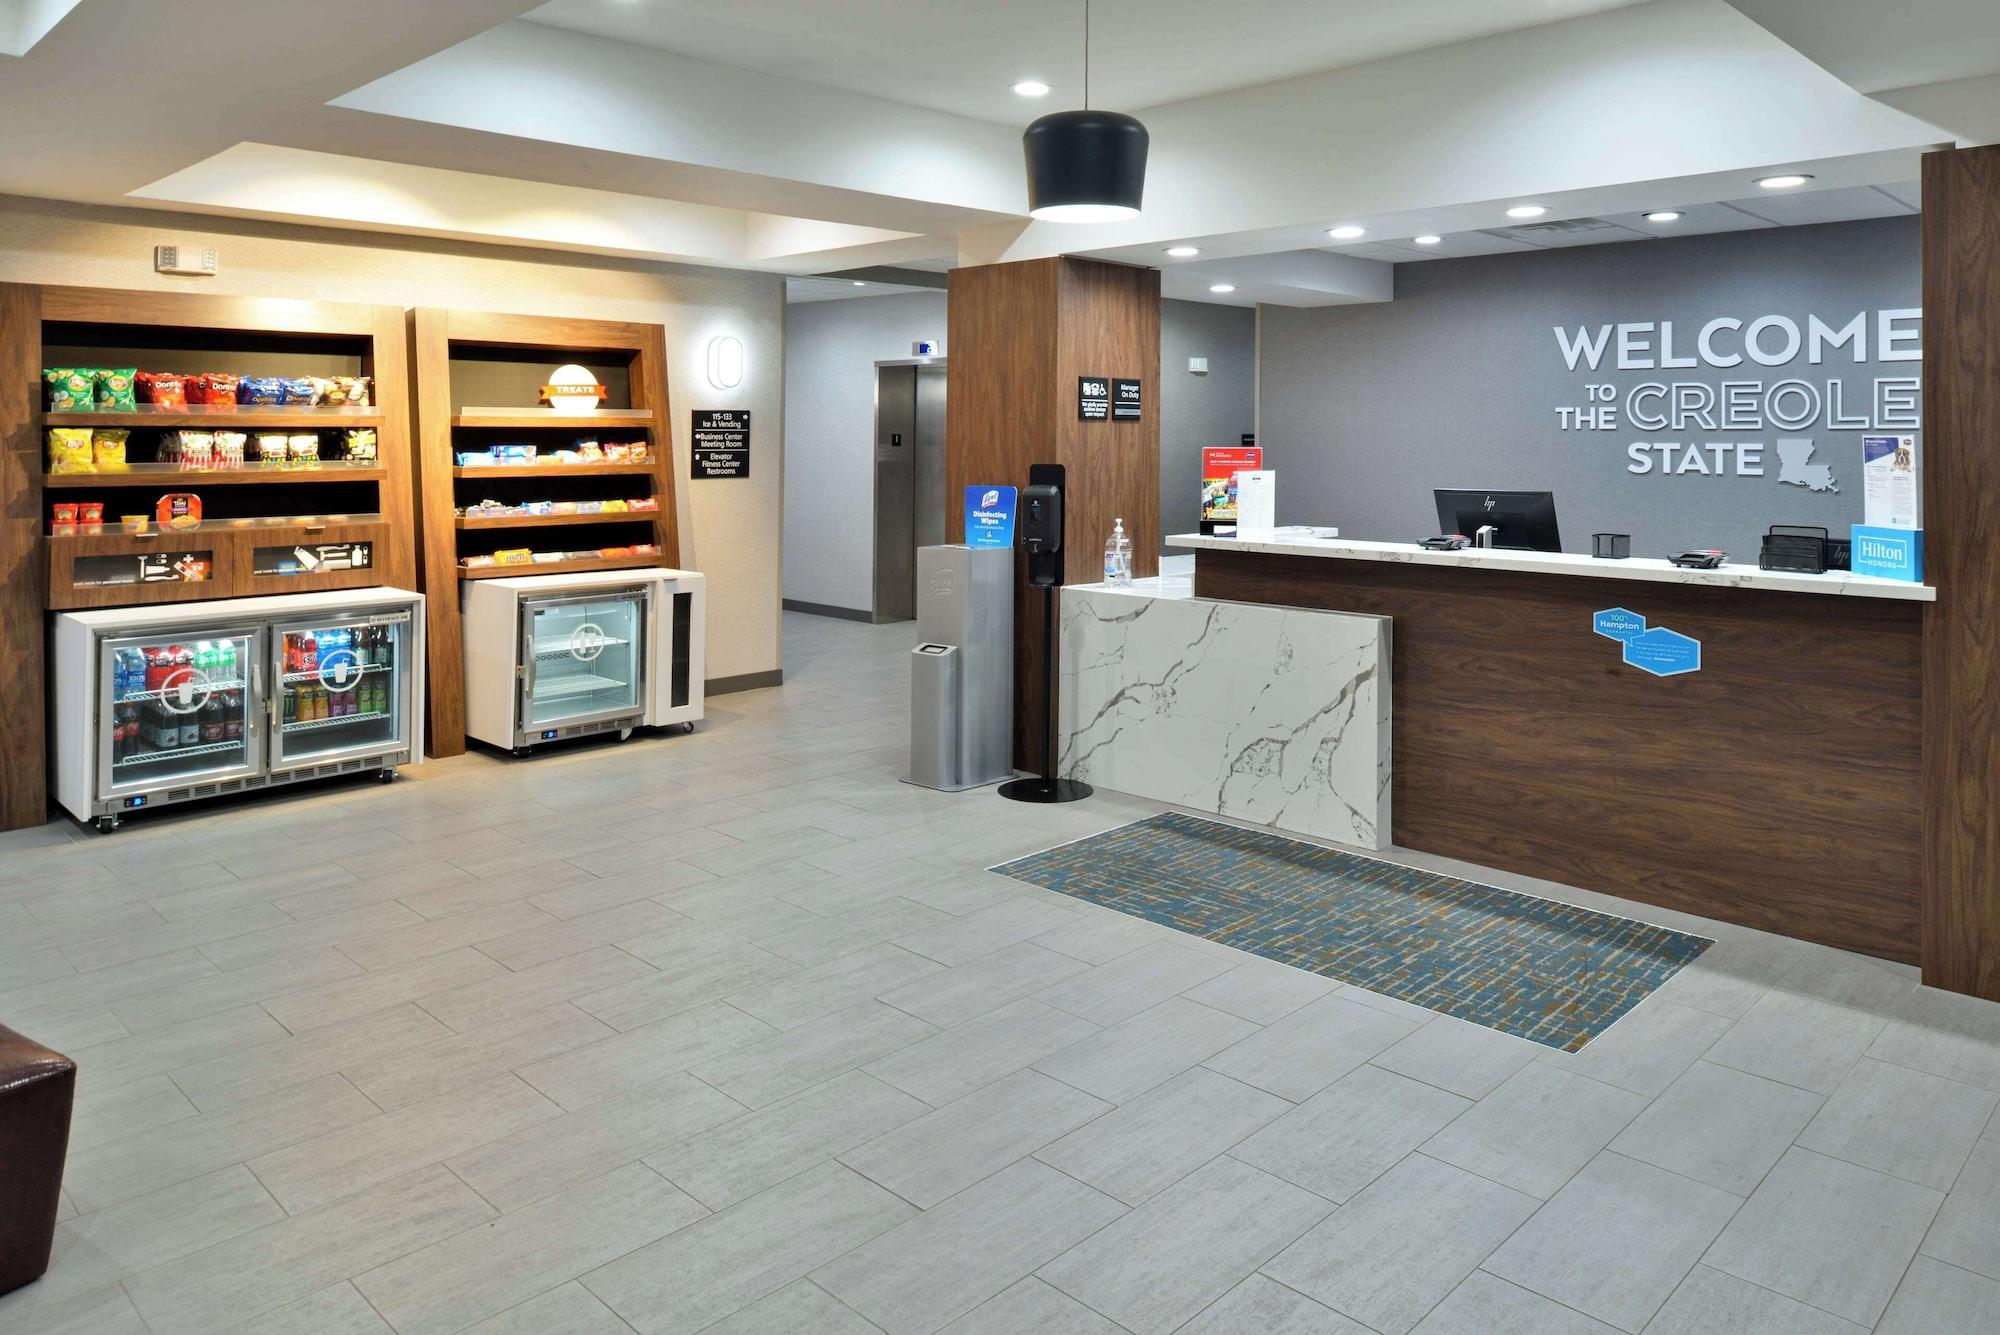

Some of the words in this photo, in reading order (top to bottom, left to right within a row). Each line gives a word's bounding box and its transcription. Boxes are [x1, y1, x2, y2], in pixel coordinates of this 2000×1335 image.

[1553, 308, 1923, 371] WELCOME
[1121, 384, 1139, 392] Manager
[1585, 384, 1617, 402] TO
[1555, 407, 1617, 430] THE
[1625, 378, 1920, 430] CREOLE
[703, 420, 711, 428] Ice
[718, 420, 741, 429] Vending
[701, 440, 725, 449] Meeting
[726, 440, 742, 448] Room
[1627, 442, 1764, 475] STATE
[1484, 495, 1496, 511] hp
[973, 511, 1007, 519] Disinfecting
[1862, 541, 1903, 560] Hilton
[1868, 560, 1897, 569] HONORS
[1600, 620, 1640, 630] Hampton
